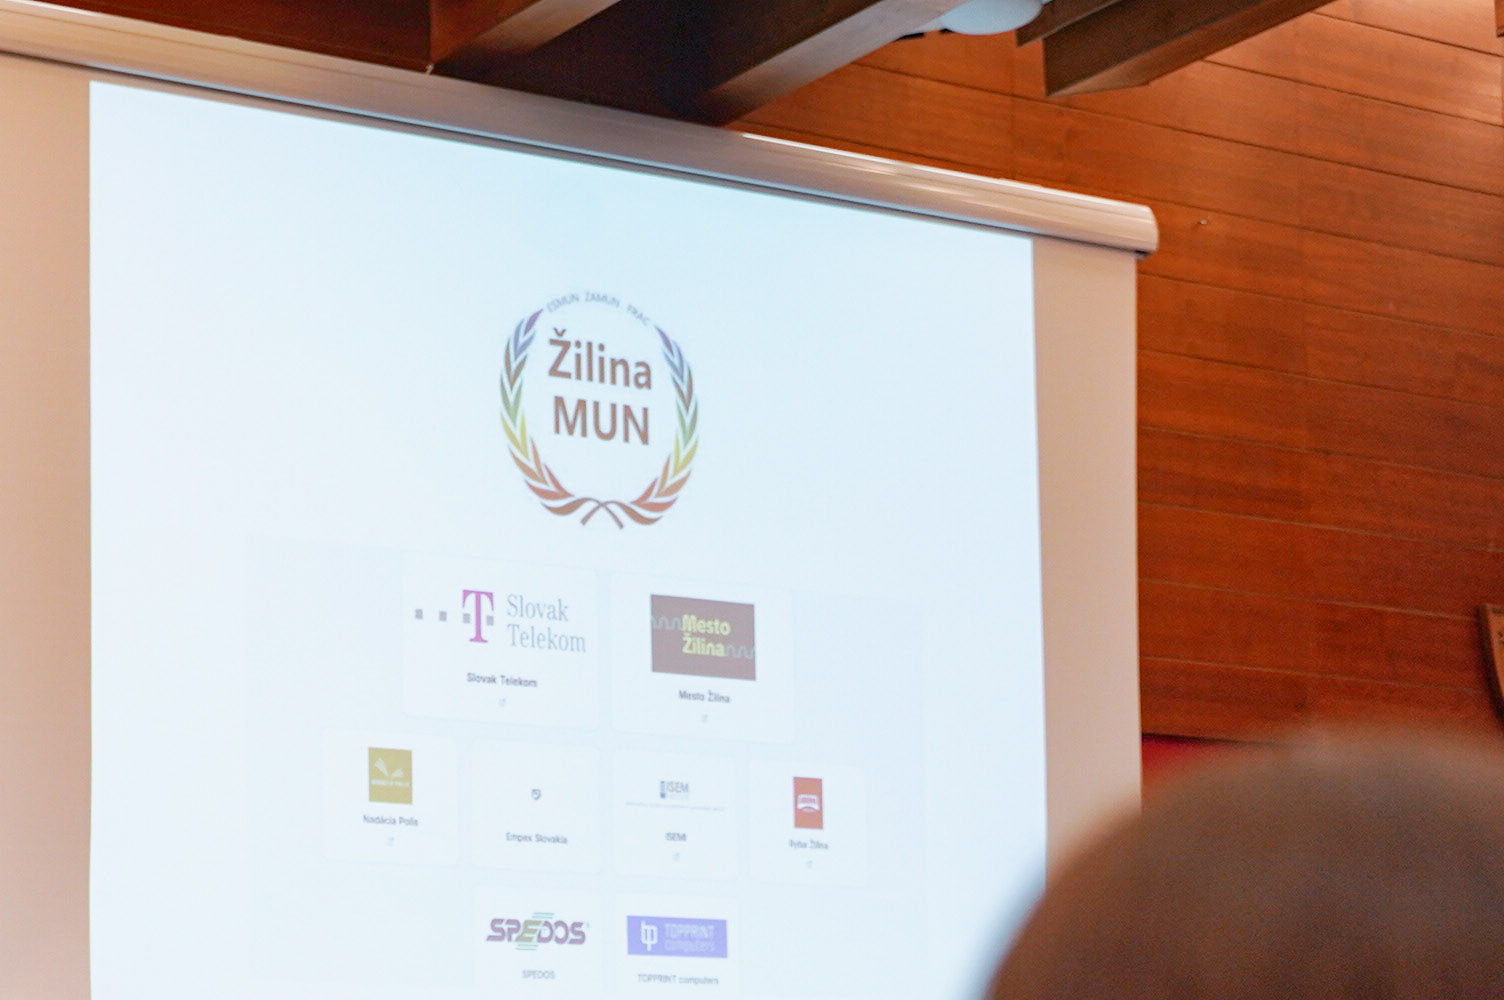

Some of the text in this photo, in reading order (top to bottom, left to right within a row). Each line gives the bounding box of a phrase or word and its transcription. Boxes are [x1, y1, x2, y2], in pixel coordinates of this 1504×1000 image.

[549, 327, 652, 390] Žilina
[554, 395, 650, 446] MUN
[507, 593, 569, 623] Slovak
[682, 614, 731, 635] Mesto
[507, 624, 586, 653] Telekom
[682, 633, 725, 657] Žilina
[466, 672, 538, 688] Slovak Telekom
[679, 688, 731, 703] Mesto Žilina
[486, 918, 586, 945] SPEDOS
[522, 969, 556, 980] SPEDOS
[638, 973, 677, 984] TOPPRINT
